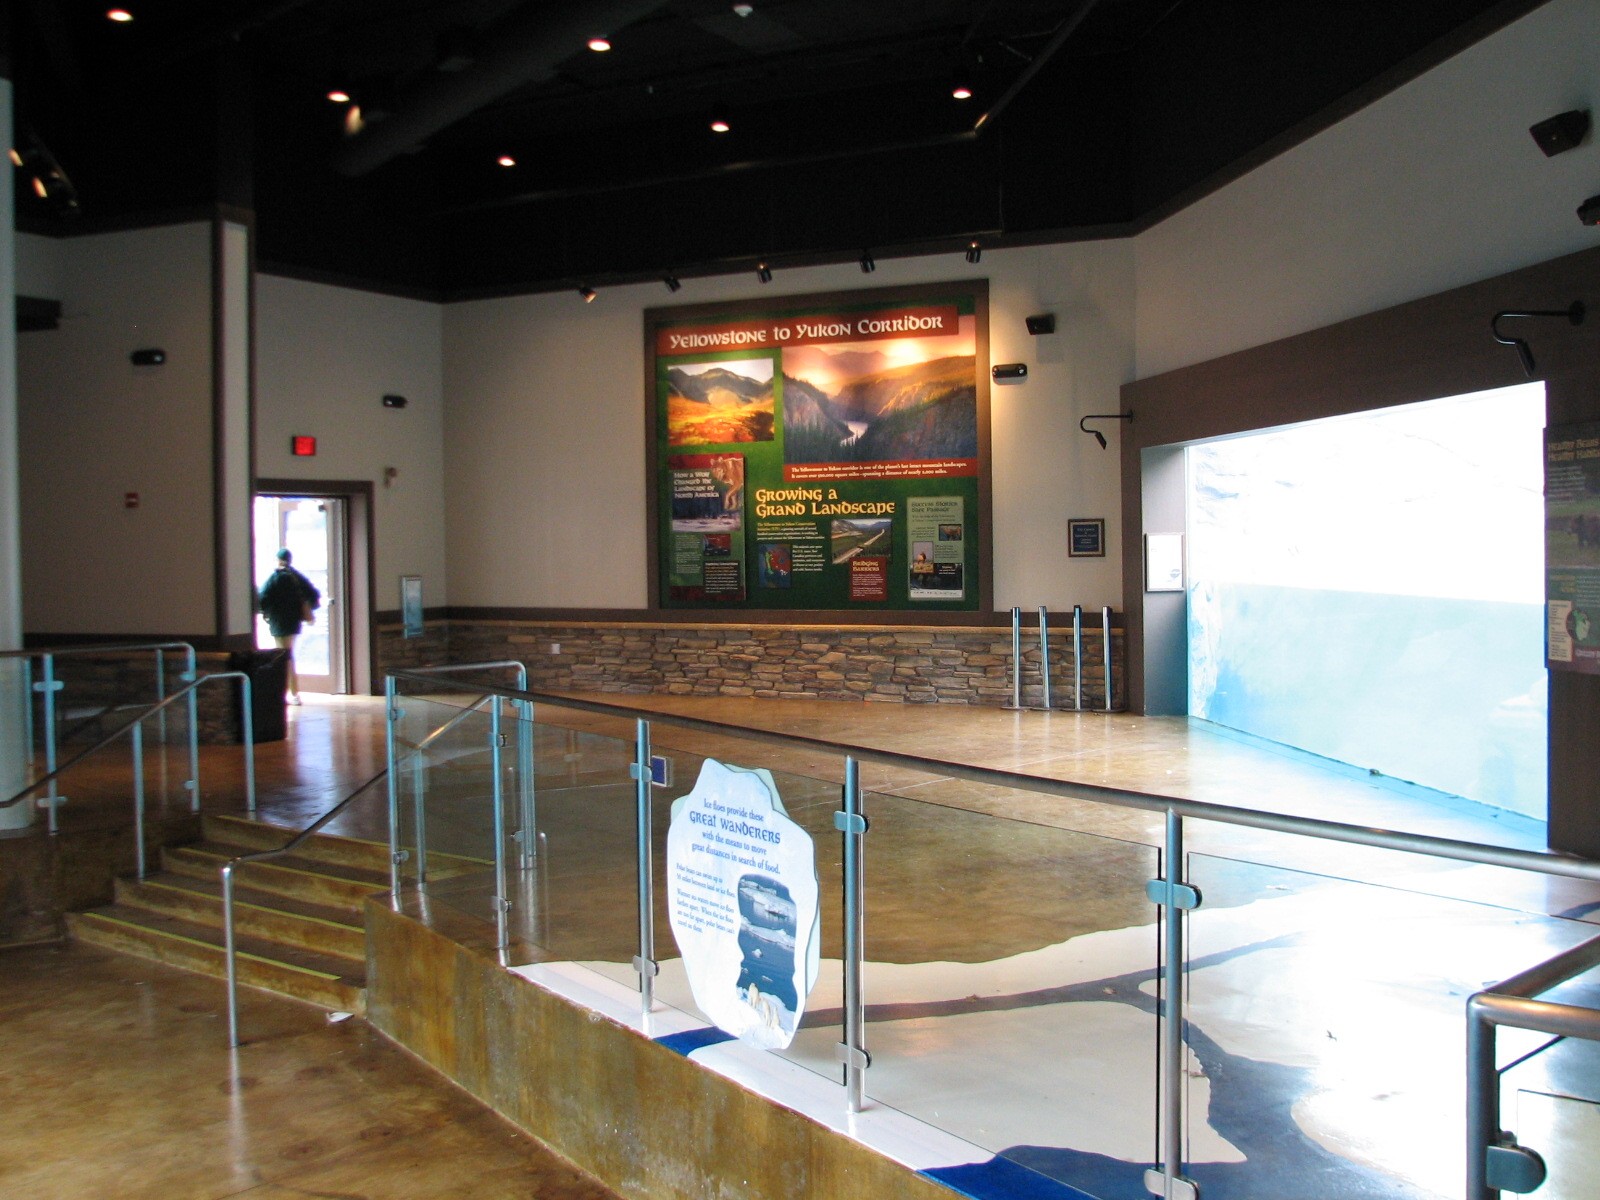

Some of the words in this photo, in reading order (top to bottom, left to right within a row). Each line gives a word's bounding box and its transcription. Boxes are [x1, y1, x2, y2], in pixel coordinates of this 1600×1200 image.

[670, 330, 766, 348] Yellowstone
[774, 329, 790, 341] to
[796, 323, 851, 339] Yukon
[857, 316, 943, 334] Corridor
[756, 487, 822, 503] Growing
[828, 489, 838, 501] a
[756, 502, 806, 518] Grand
[812, 500, 895, 516] Landscape
[704, 798, 712, 809] Ice
[713, 800, 725, 812] floes
[726, 806, 748, 817] provide
[749, 809, 764, 822] these
[702, 831, 714, 841] with
[715, 832, 724, 843] the
[725, 838, 742, 849] means
[744, 842, 750, 851] to
[751, 845, 767, 856] move
[692, 843, 705, 853] great
[706, 844, 730, 859] distances
[731, 851, 738, 862] in
[738, 856, 756, 867] search
[758, 859, 764, 870] of
[764, 860, 781, 874] food.
